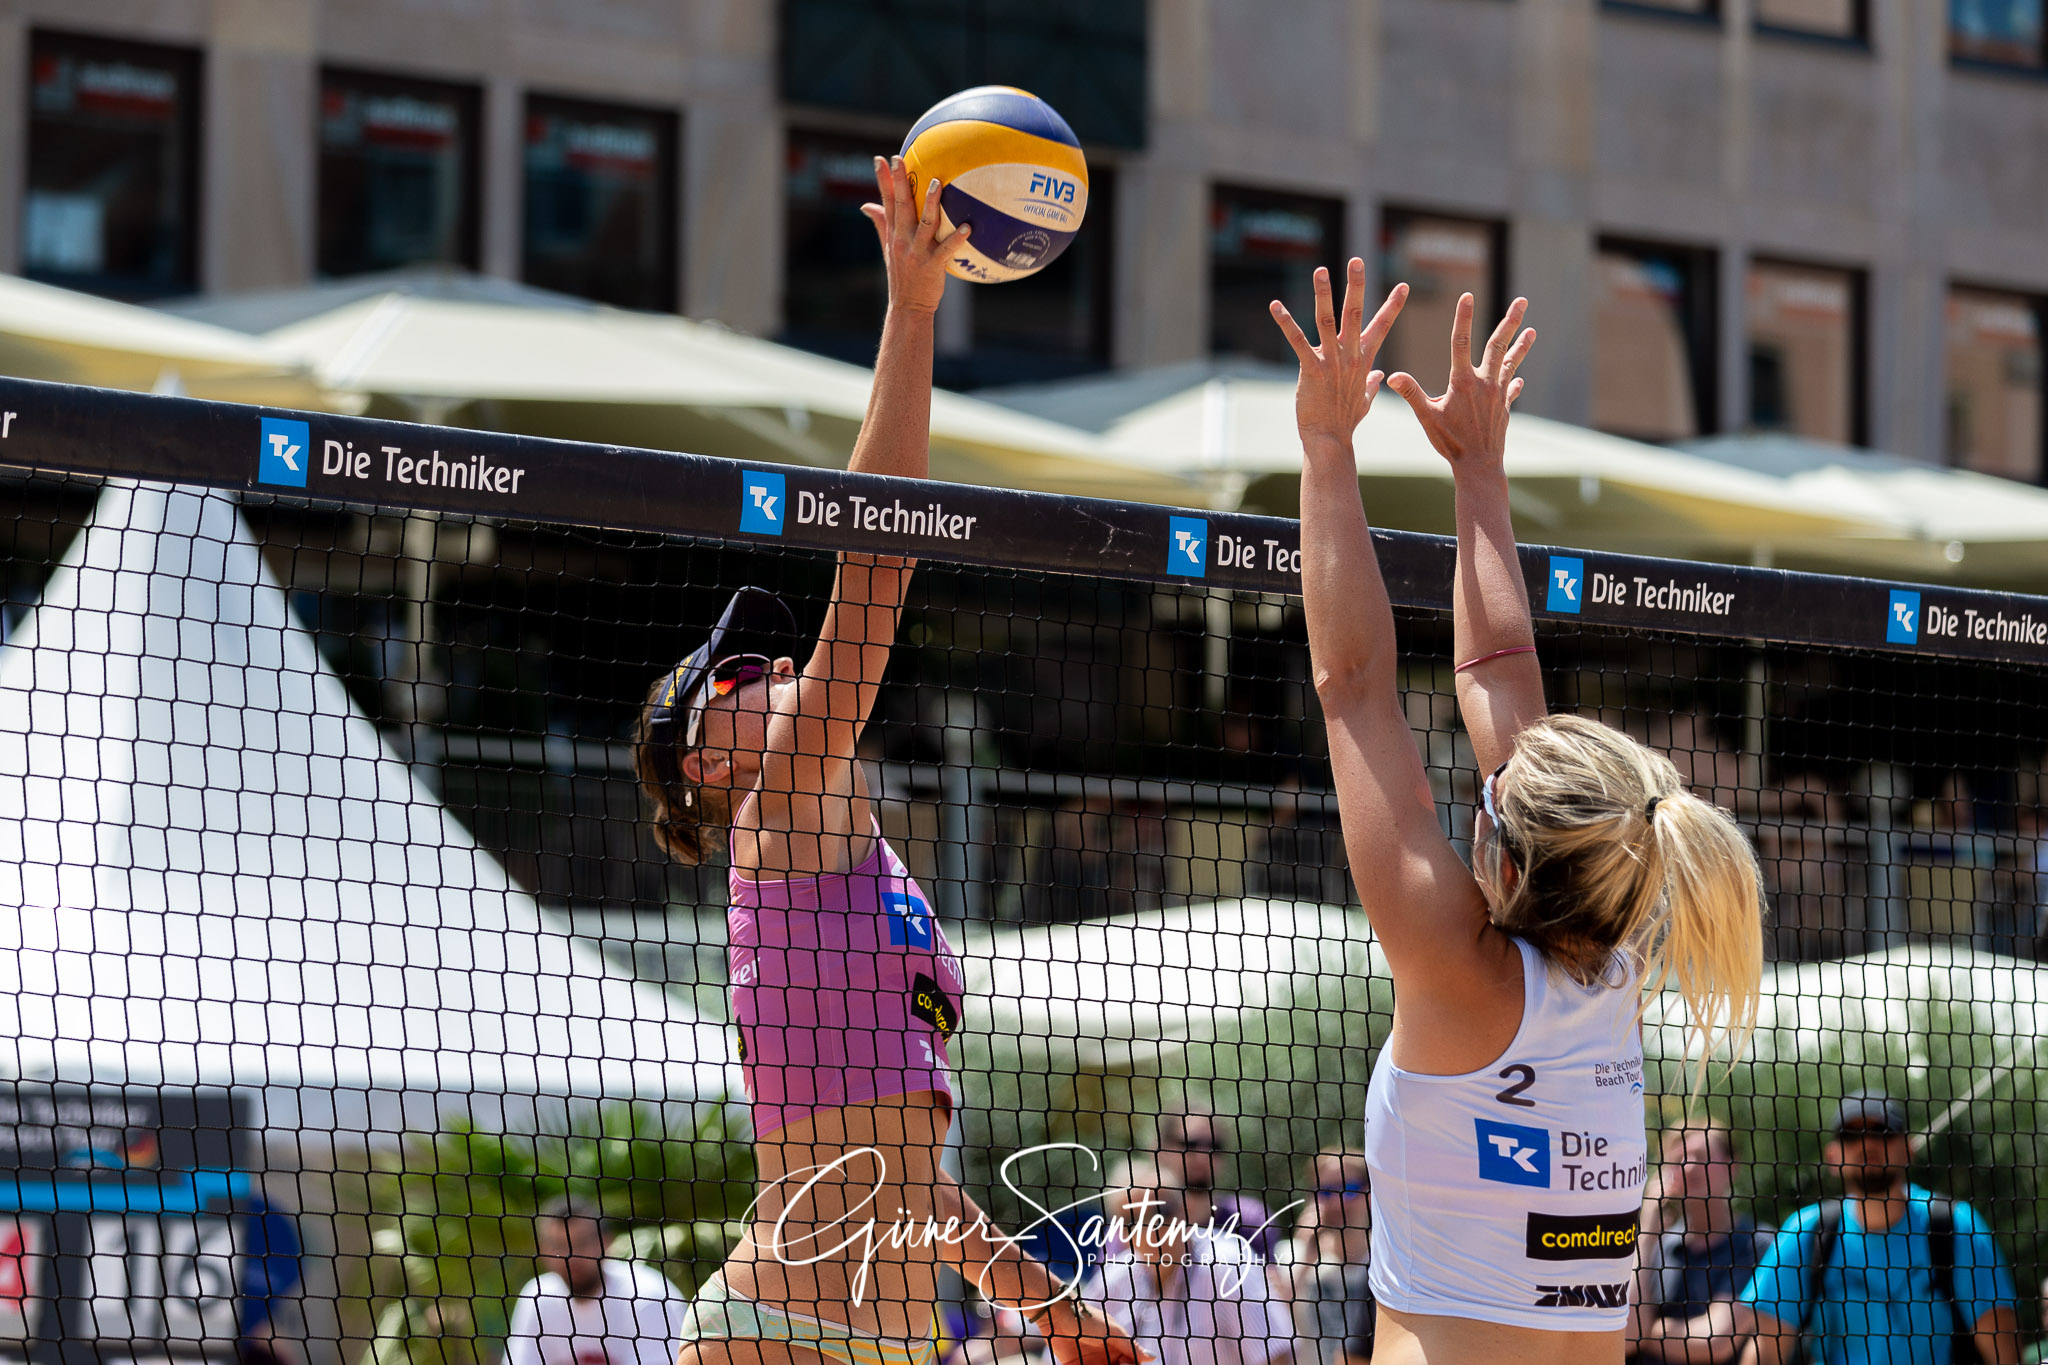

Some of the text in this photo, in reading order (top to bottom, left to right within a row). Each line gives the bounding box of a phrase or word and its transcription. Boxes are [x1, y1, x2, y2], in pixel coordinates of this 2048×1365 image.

[1029, 172, 1075, 203] FIVB
[1023, 204, 1047, 217] OFFICIAL
[322, 440, 369, 480] Die
[381, 446, 525, 495] Techniker
[797, 491, 840, 527] Die
[849, 496, 977, 541] Techniker
[1218, 535, 1256, 569] Die
[1592, 573, 1625, 605] Die
[1633, 576, 1735, 615] Techniker
[1927, 606, 1959, 637] Die
[1964, 609, 2048, 645] Technike
[1594, 1062, 1610, 1075] Die
[1595, 1070, 1640, 1087] Beach Tour
[1495, 1063, 1536, 1108] 2
[1561, 1131, 1608, 1157] Die
[1541, 1223, 1636, 1249] comdirect
